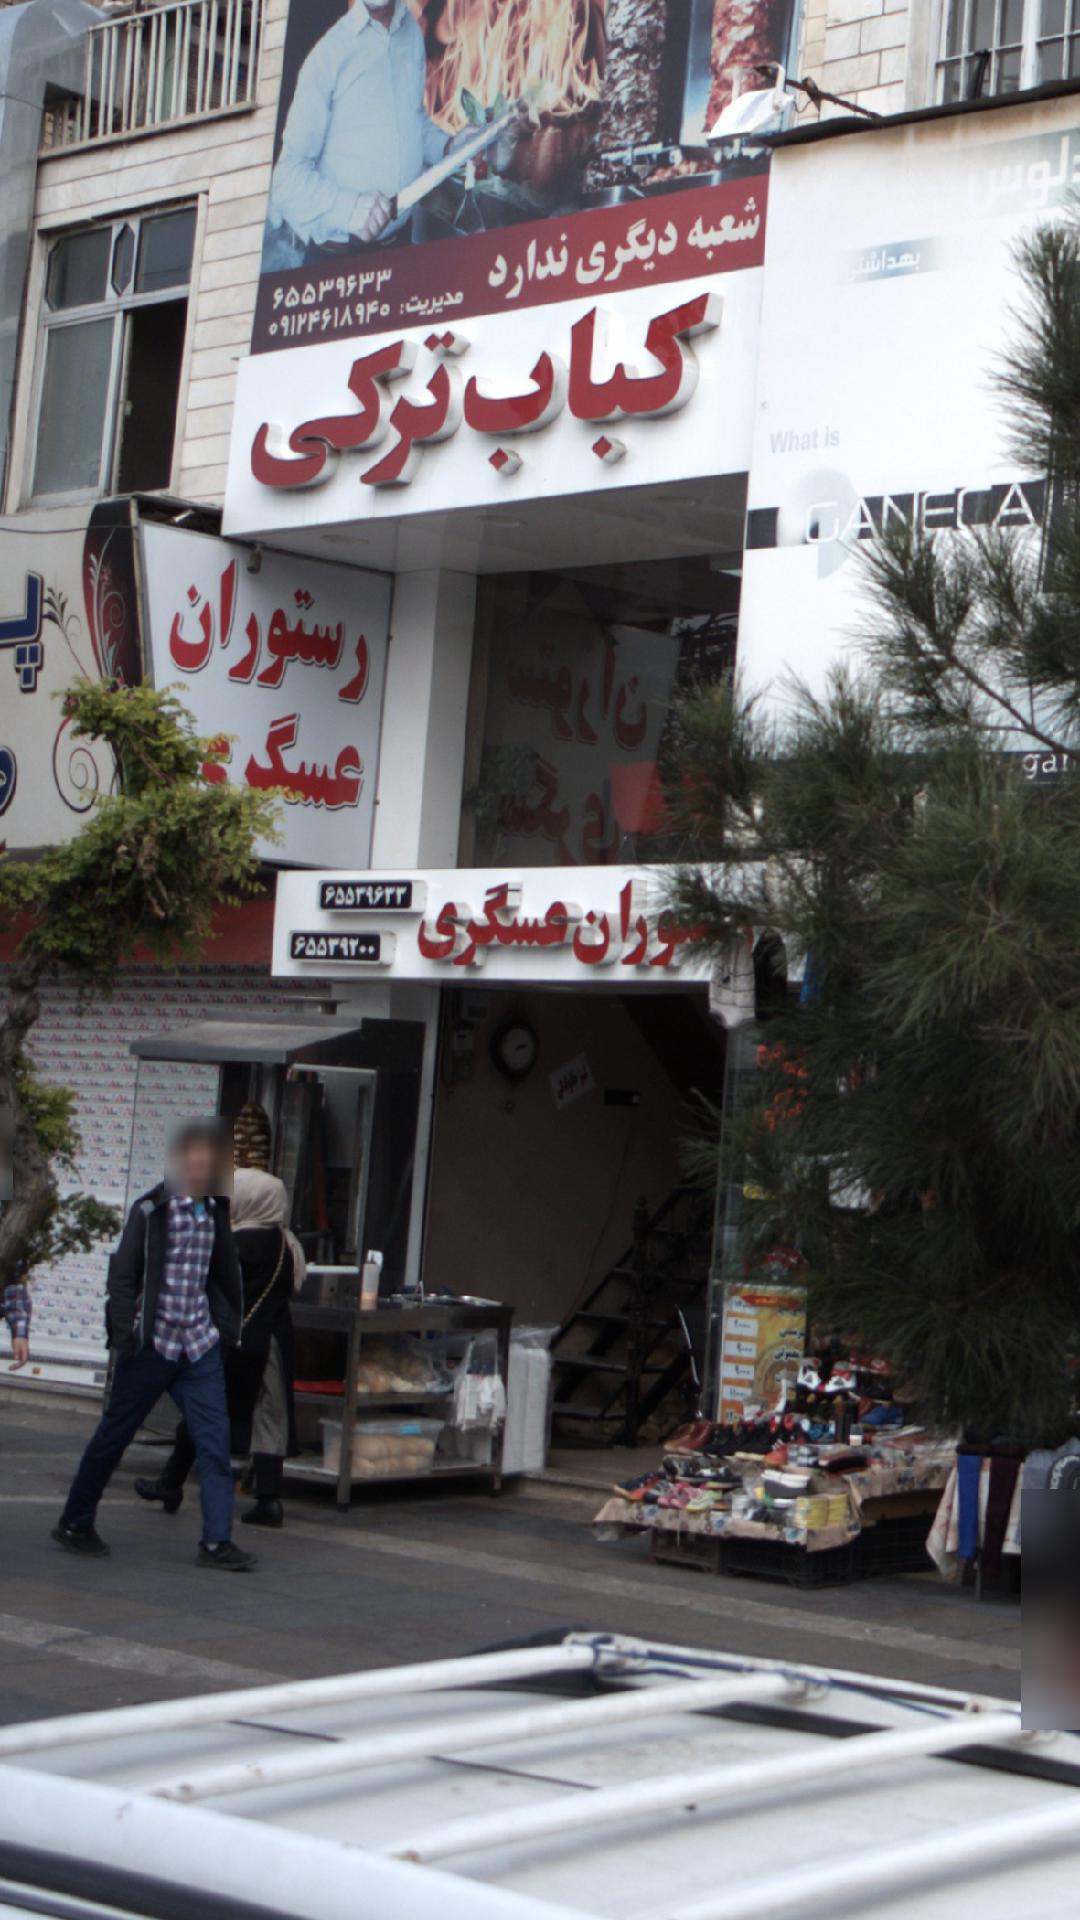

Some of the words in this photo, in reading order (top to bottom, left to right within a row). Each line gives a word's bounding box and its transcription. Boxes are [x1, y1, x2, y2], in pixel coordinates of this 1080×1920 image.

[575, 218, 678, 284] دیگری
[687, 197, 760, 260] شعبه
[272, 268, 392, 310] ۶۵۵۳۹۶۳۳
[488, 233, 568, 299] ندارد
[269, 301, 390, 337] ۰۹۱۲۴۶۱۸۹۴۰
[400, 290, 464, 316] مدیریت:
[251, 332, 460, 489] ترکی
[463, 292, 719, 474] کباب
[769, 427, 819, 454] What
[823, 426, 840, 447] is
[169, 558, 370, 704] رستوران
[417, 882, 571, 966] عسگری
